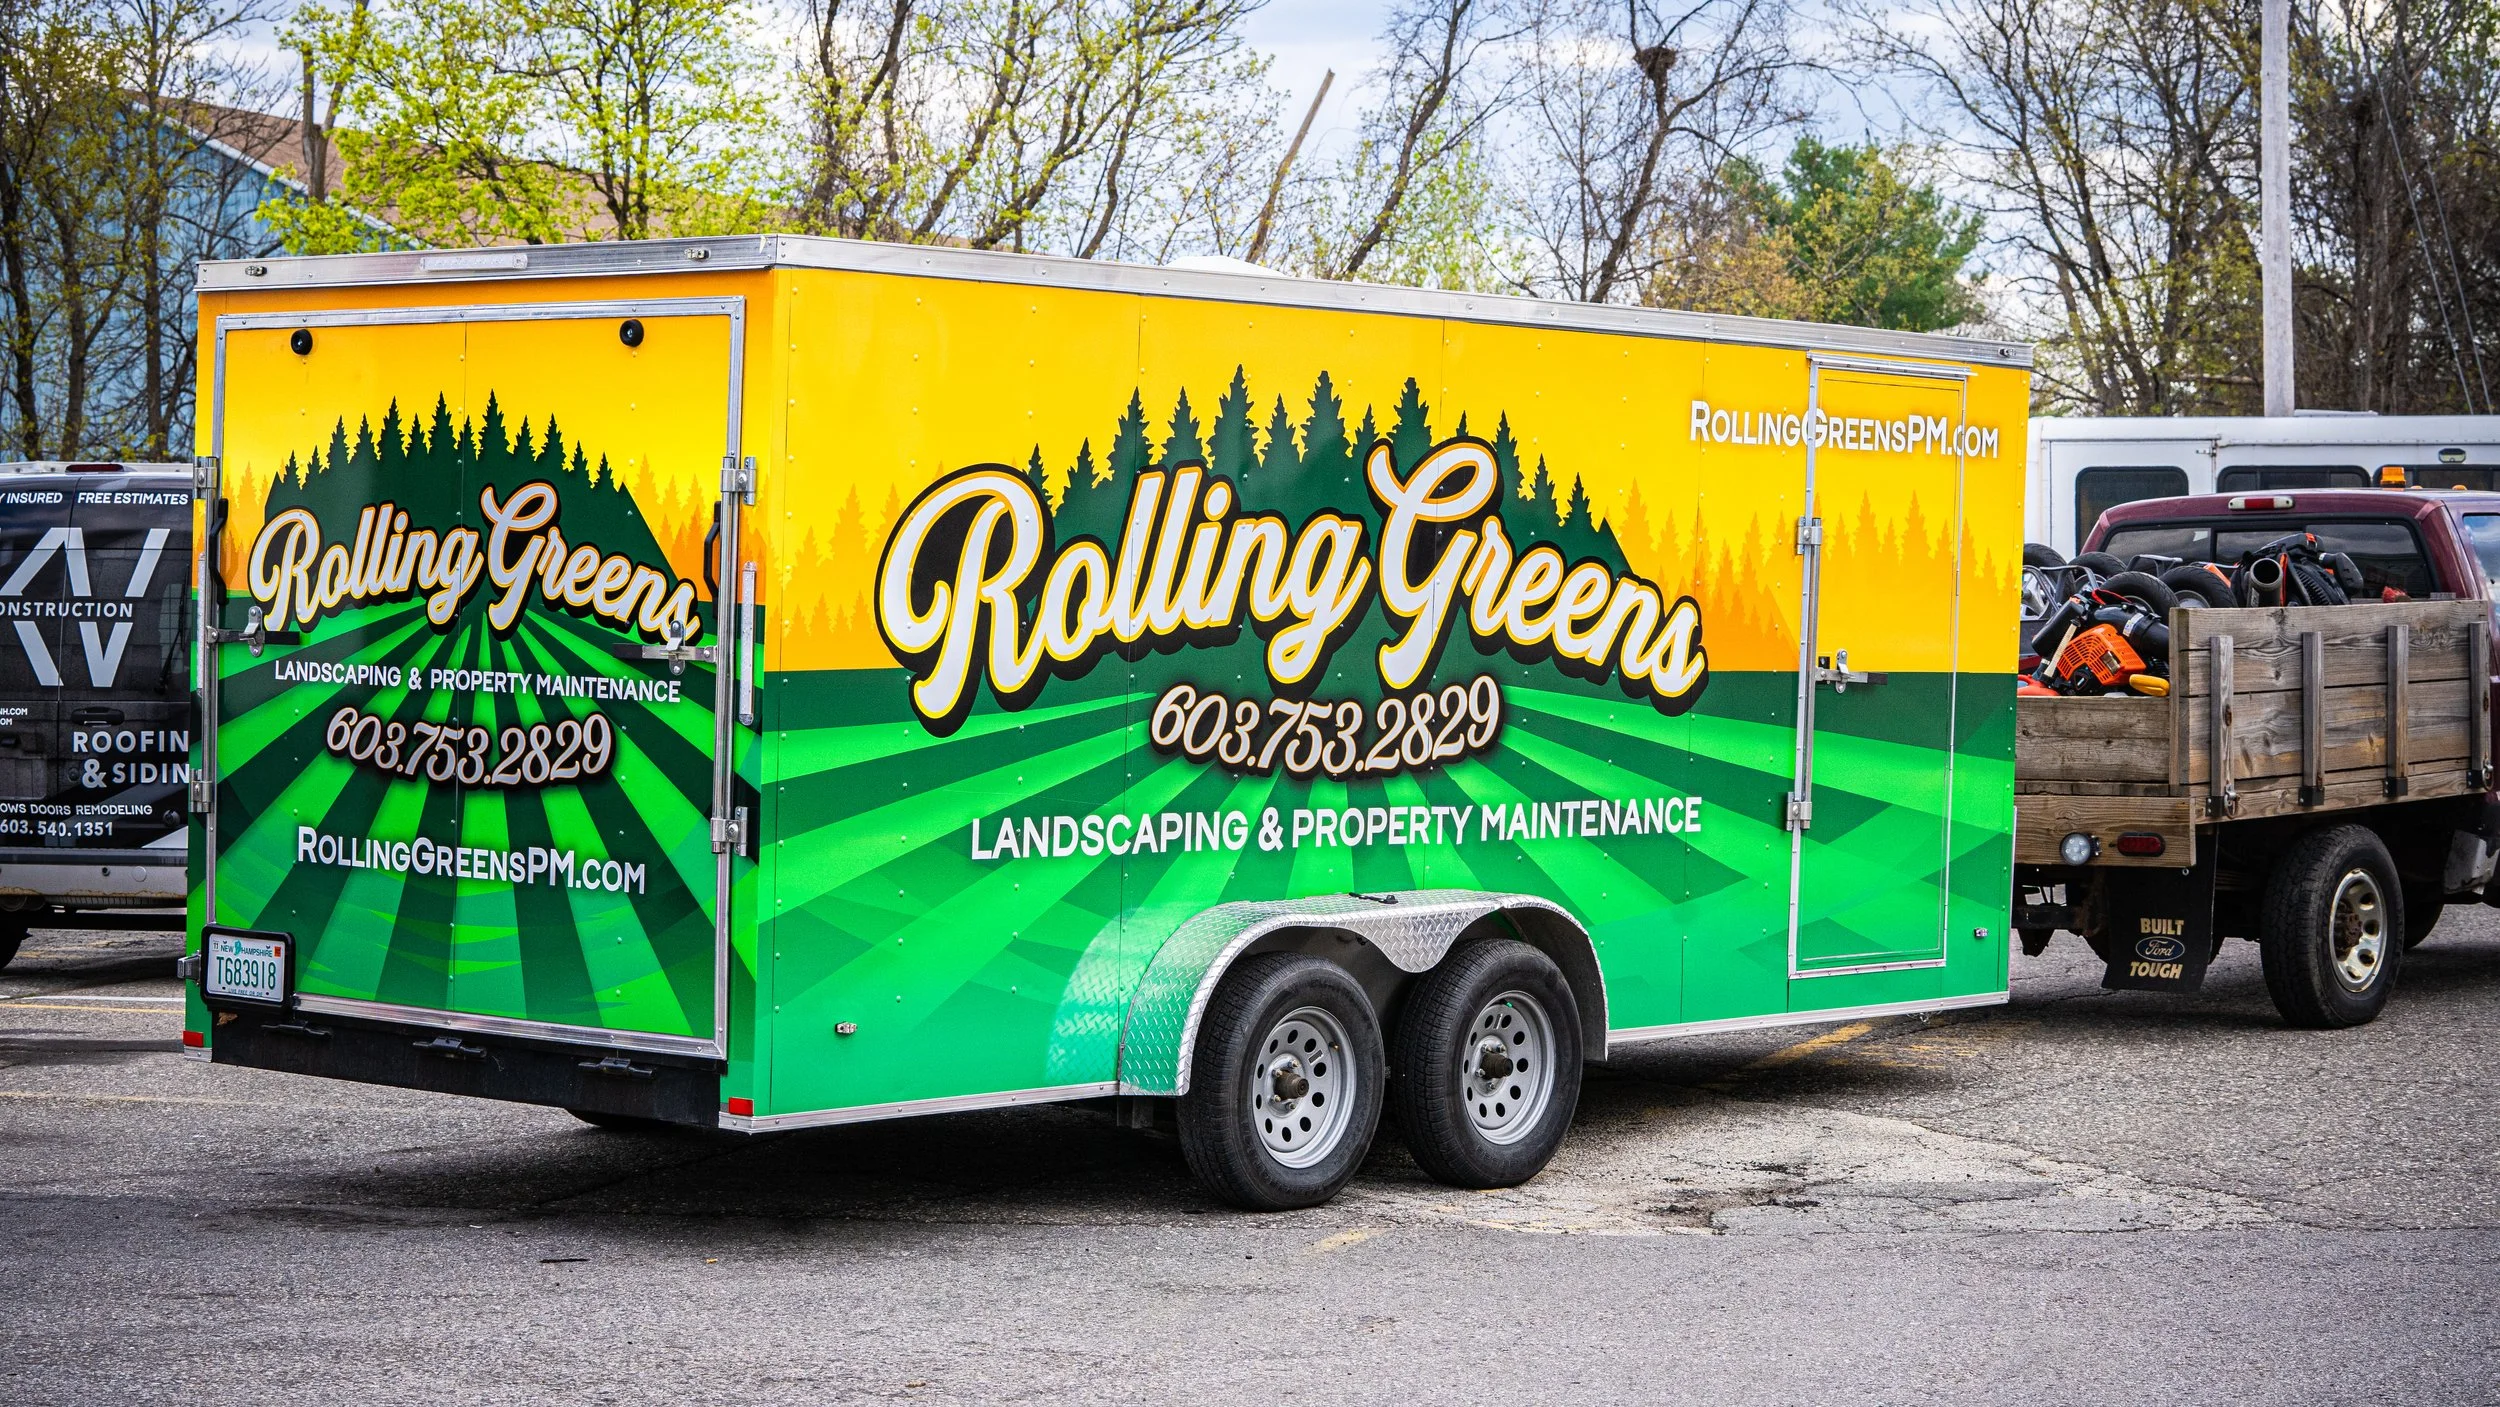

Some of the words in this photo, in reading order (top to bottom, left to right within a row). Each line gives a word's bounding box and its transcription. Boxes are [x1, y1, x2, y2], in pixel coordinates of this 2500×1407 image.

[7, 492, 63, 504] INSURED
[78, 492, 110, 504] FREE
[114, 494, 188, 505] ESTIMATES
[251, 503, 482, 632] Rolling
[480, 482, 701, 642] Greens
[882, 471, 1370, 719] Rolling
[1366, 437, 1705, 697] Greens
[274, 660, 401, 687] LANDSCAPING
[408, 668, 422, 690] &
[430, 668, 532, 694] PROPERTY
[536, 675, 681, 703] MAINTENANCE
[1150, 676, 1499, 776] 603.753.2829
[327, 707, 612, 784] 603.753.2829
[82, 758, 107, 789] &
[30, 804, 71, 815] DOORS
[76, 804, 153, 815] REMODELING
[971, 812, 1248, 861] LANDSCAPING
[1258, 807, 1283, 850] &
[1291, 805, 1472, 849] PROPERTY
[1481, 796, 1702, 842] MAINTENANCE
[2140, 917, 2184, 935] BUILT
[220, 944, 234, 953] NEW
[241, 948, 273, 958] HAMPSHIRE
[2145, 939, 2175, 956] Ford
[216, 956, 276, 990] T683918
[2129, 961, 2183, 979] TOUGH
